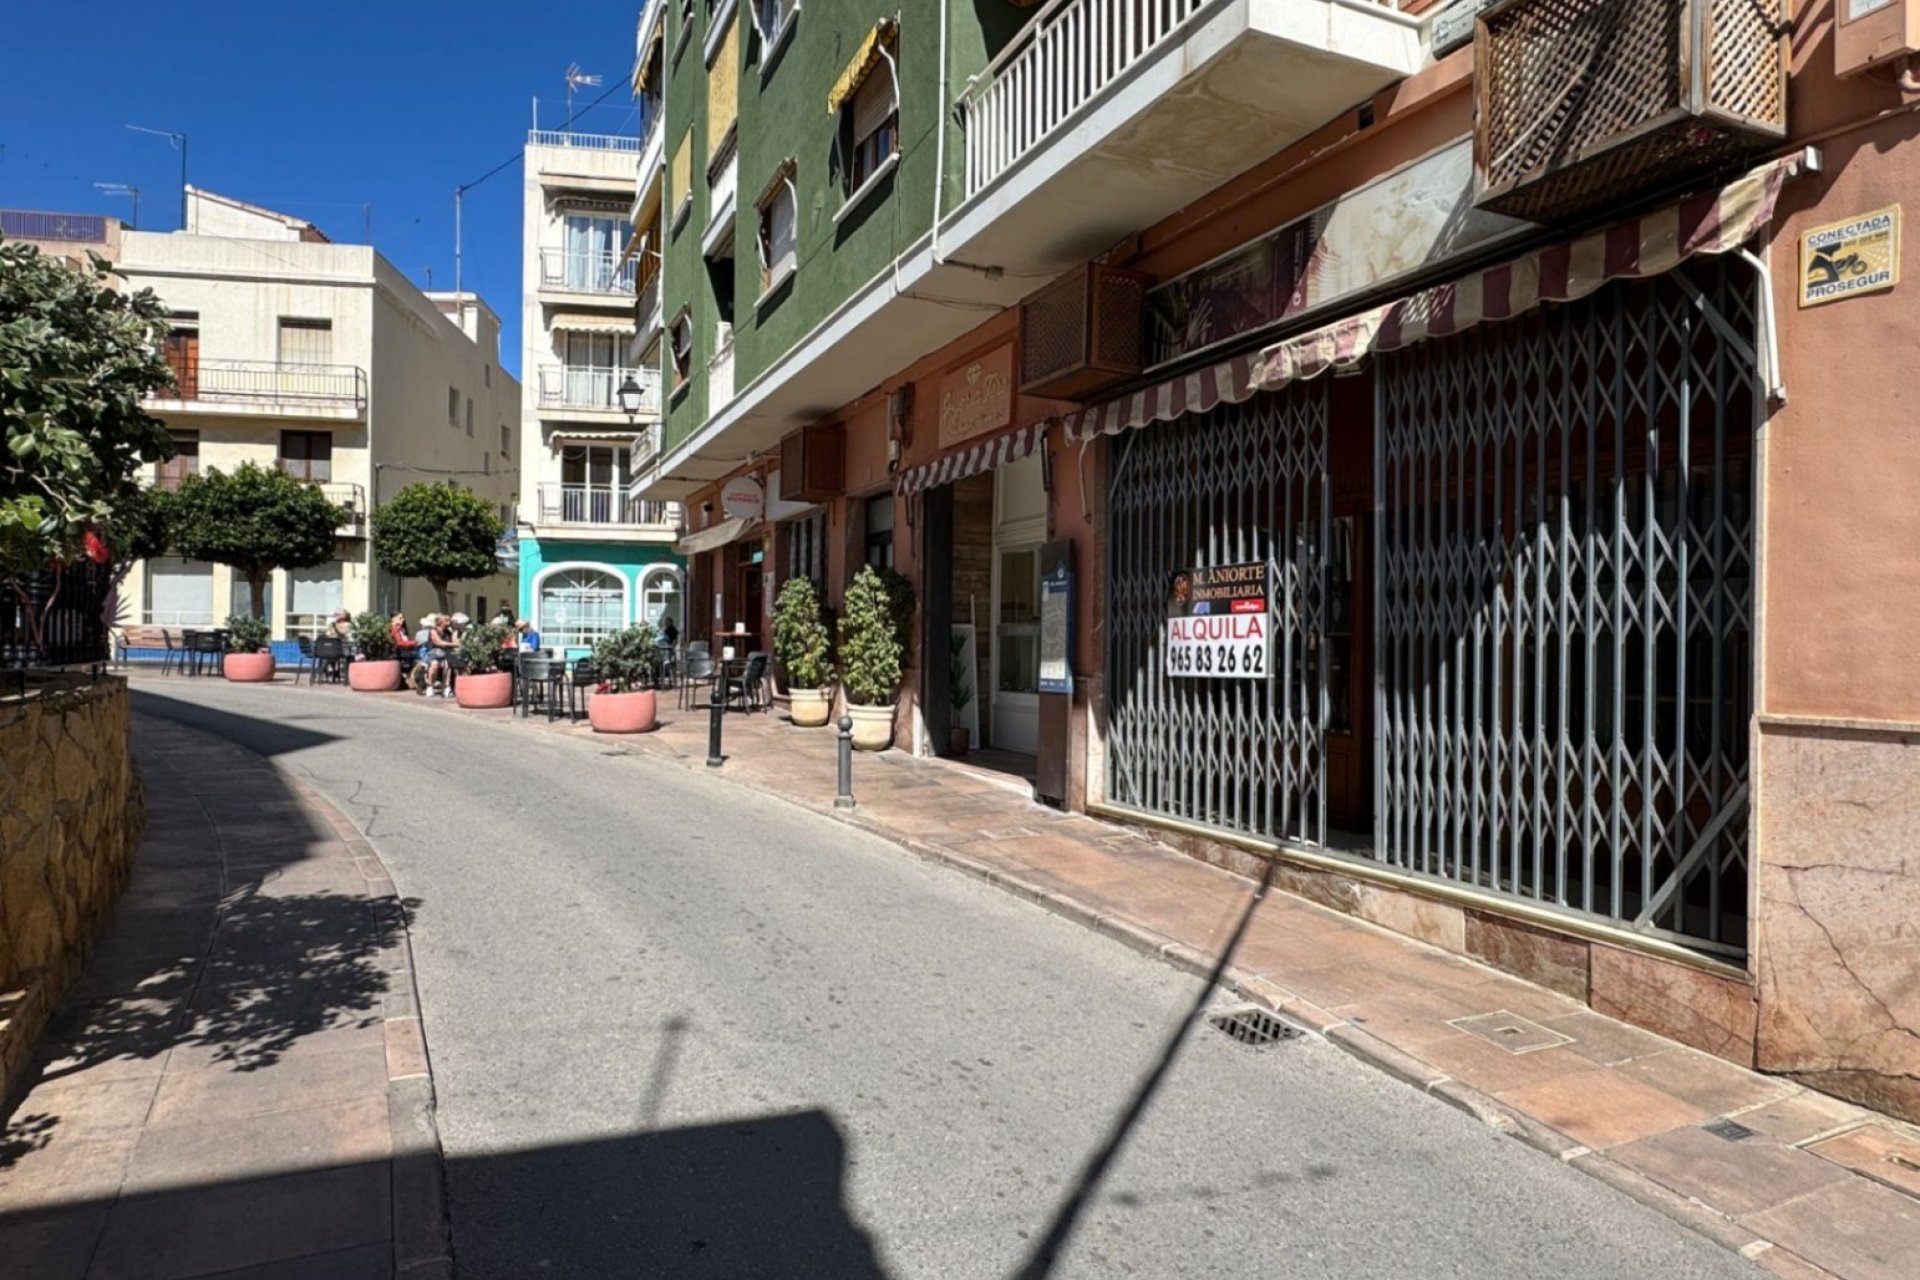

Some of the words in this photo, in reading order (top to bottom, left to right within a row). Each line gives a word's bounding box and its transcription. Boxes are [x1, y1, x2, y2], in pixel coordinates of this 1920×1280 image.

[1807, 214, 1891, 245] CONECTADA
[1806, 271, 1890, 299] PROSEGUR
[1208, 565, 1265, 584] ANIORTE
[1192, 584, 1265, 601] INMOBILIARIA
[1171, 616, 1263, 641] ALQUILA
[1170, 645, 1191, 672] 965
[1195, 644, 1212, 672] 83
[1217, 645, 1236, 673] 26
[1243, 644, 1263, 673] 62
